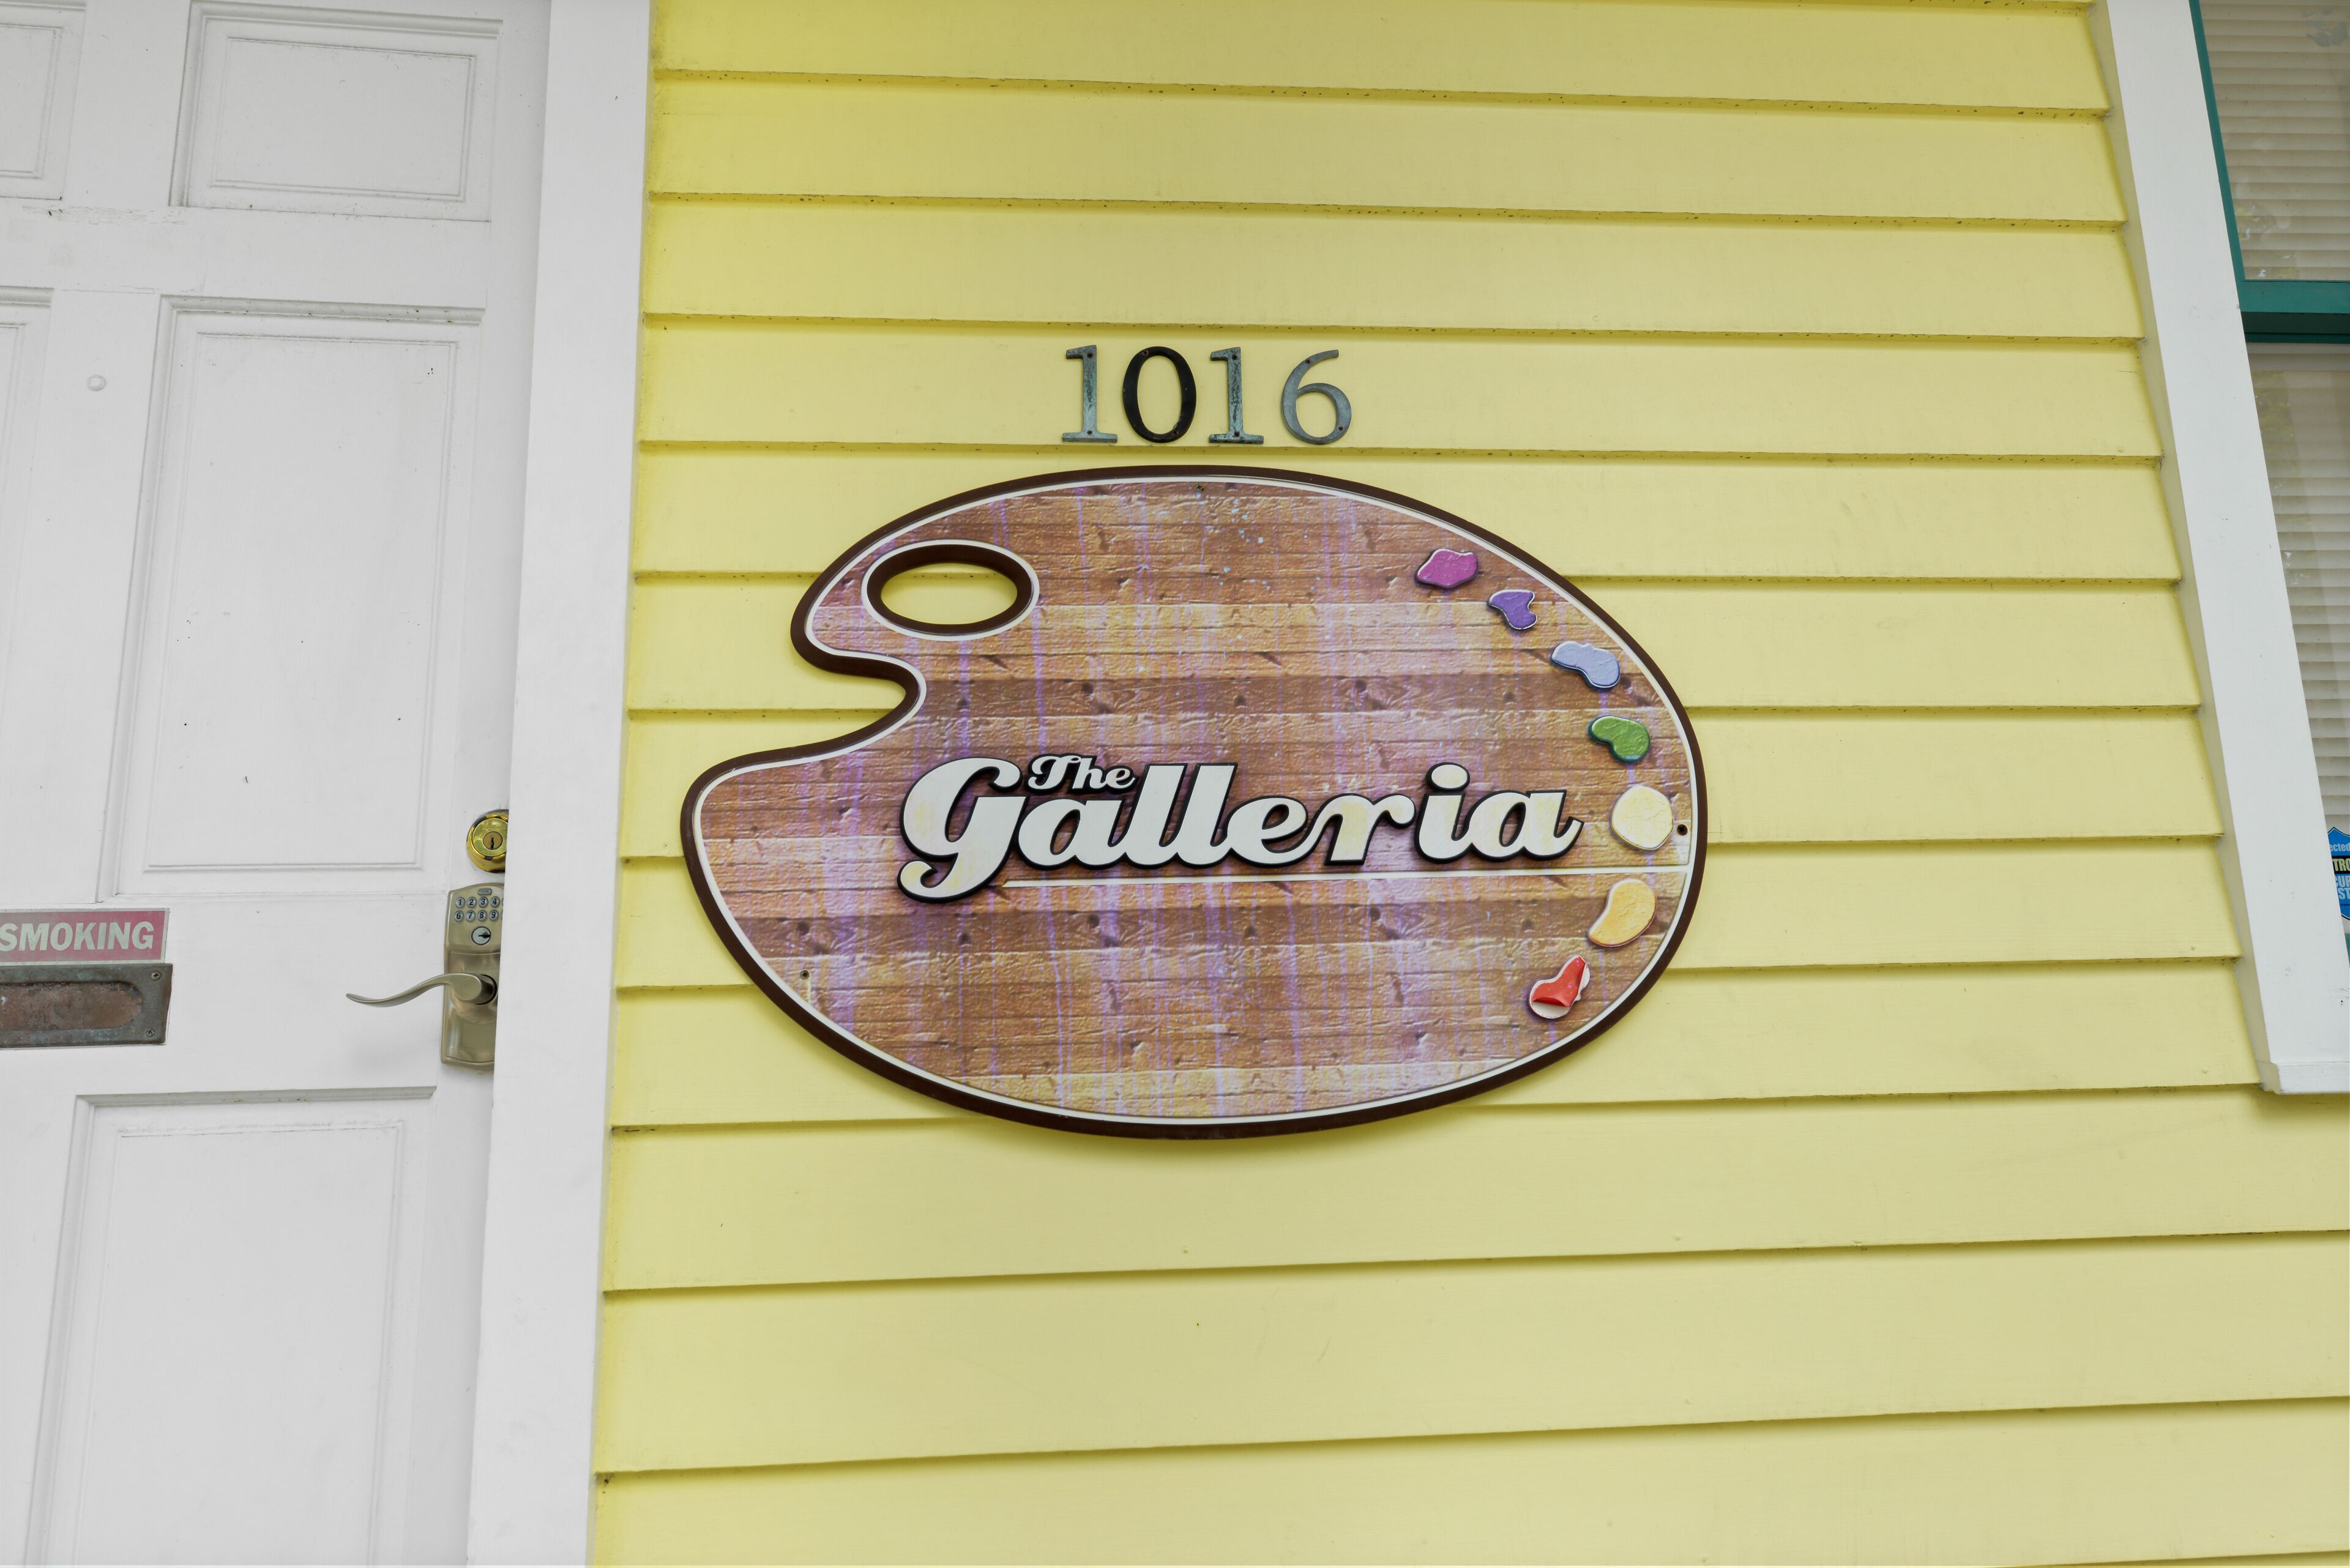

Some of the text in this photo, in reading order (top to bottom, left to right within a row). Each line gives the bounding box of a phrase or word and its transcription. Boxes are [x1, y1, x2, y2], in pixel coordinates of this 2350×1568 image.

[1062, 344, 1352, 445] 1016
[1027, 753, 1140, 794] The
[897, 756, 1584, 904] Galleria
[0, 921, 154, 952] SMOKING
